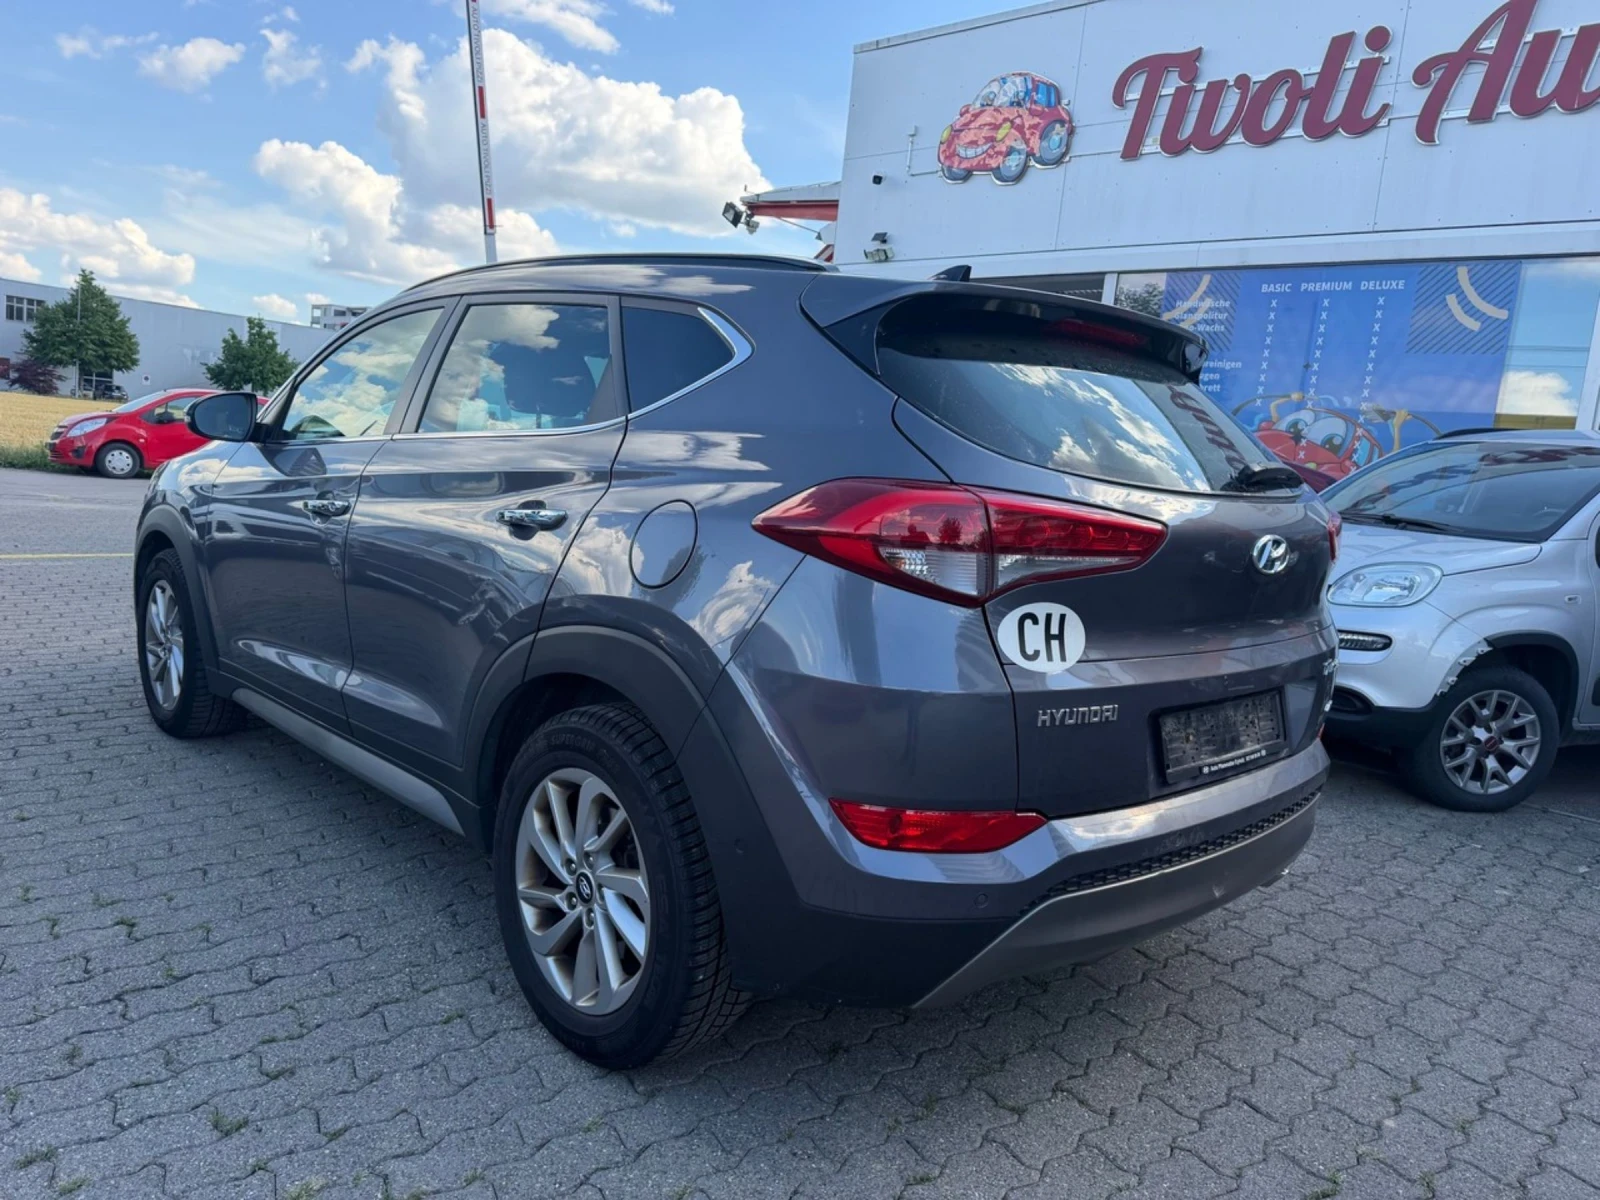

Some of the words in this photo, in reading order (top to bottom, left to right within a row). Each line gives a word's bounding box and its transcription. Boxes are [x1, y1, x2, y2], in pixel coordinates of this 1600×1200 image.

[1112, 25, 1392, 161] Tivoli
[1412, 0, 1600, 145] Au
[1261, 283, 1292, 293] BASIC
[1300, 281, 1352, 292] PREMIUM
[1360, 280, 1405, 290] DELUXE
[1017, 612, 1067, 662] CH
[1037, 704, 1119, 727] HYUNDAI
